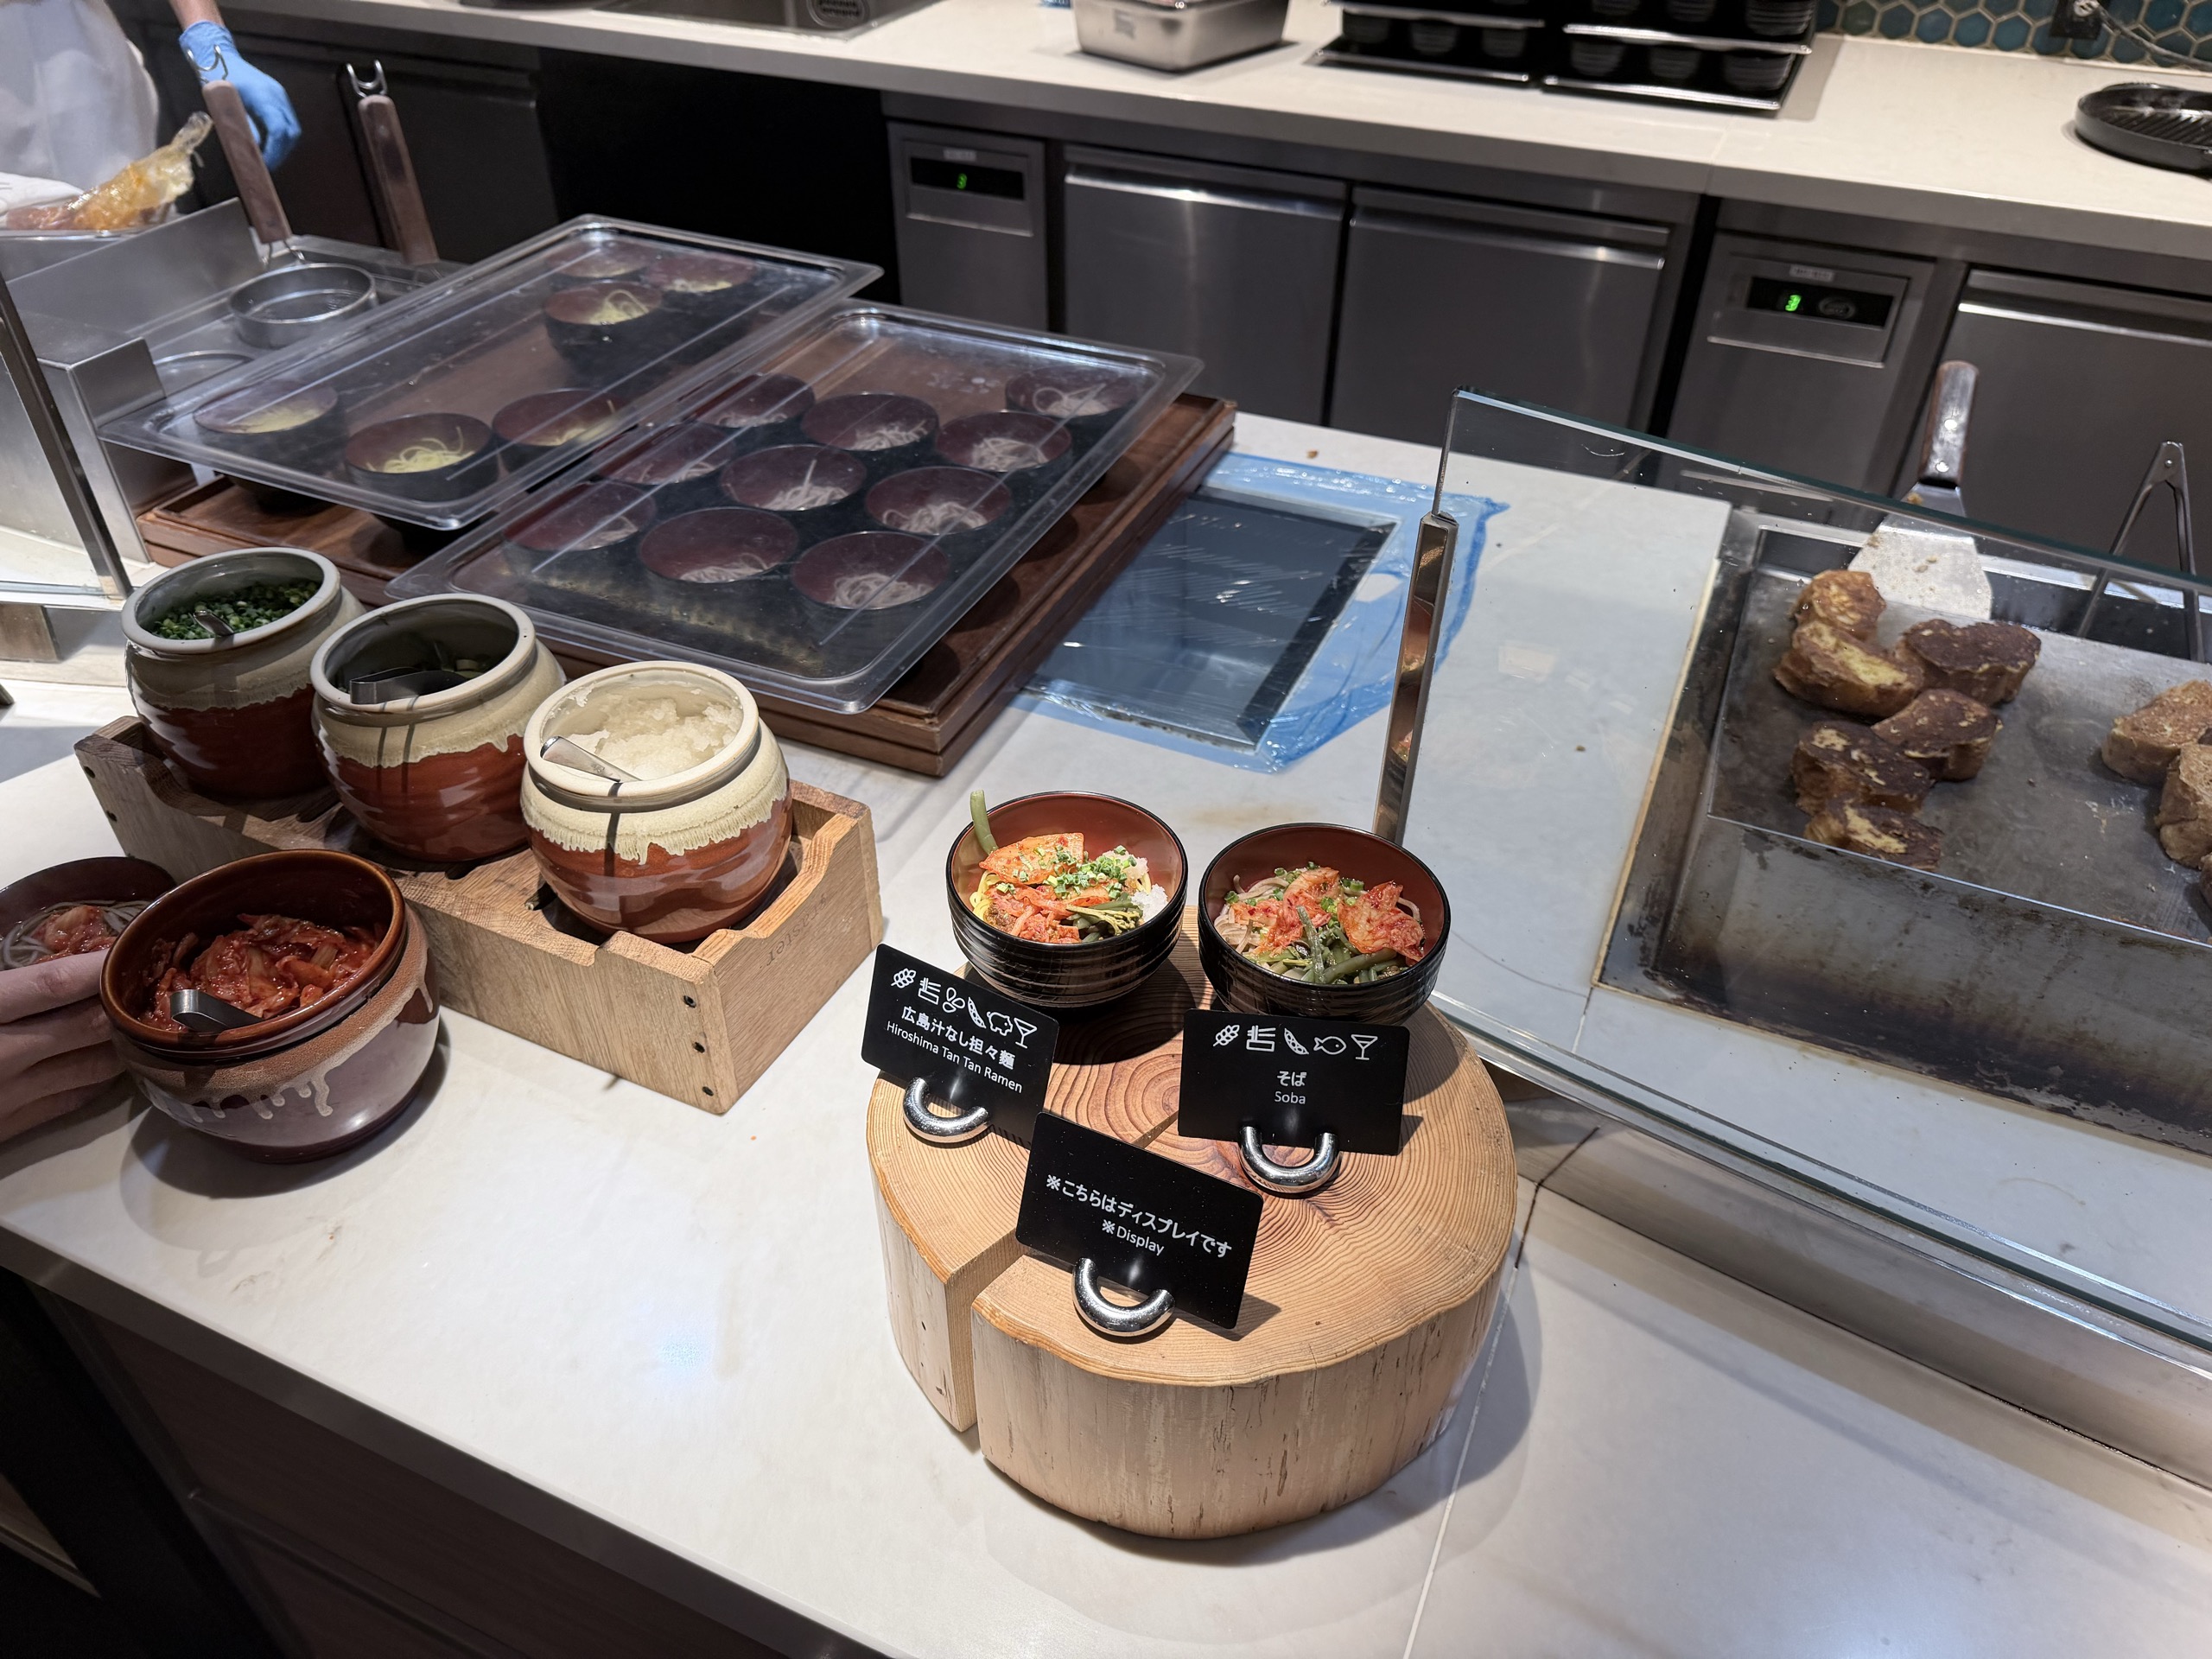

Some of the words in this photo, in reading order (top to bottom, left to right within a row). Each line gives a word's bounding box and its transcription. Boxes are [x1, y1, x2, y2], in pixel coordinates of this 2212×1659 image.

[1785, 295, 1801, 312] 3
[887, 1022, 939, 1053] Hiroshima
[942, 1046, 960, 1065] Tan
[963, 1056, 982, 1075] Tan
[983, 1066, 1023, 1094] Ramen
[1276, 1071, 1307, 1086] そば
[1274, 1091, 1306, 1104] Soba
[1046, 1174, 1232, 1258] ※こちらはディスプレイです
